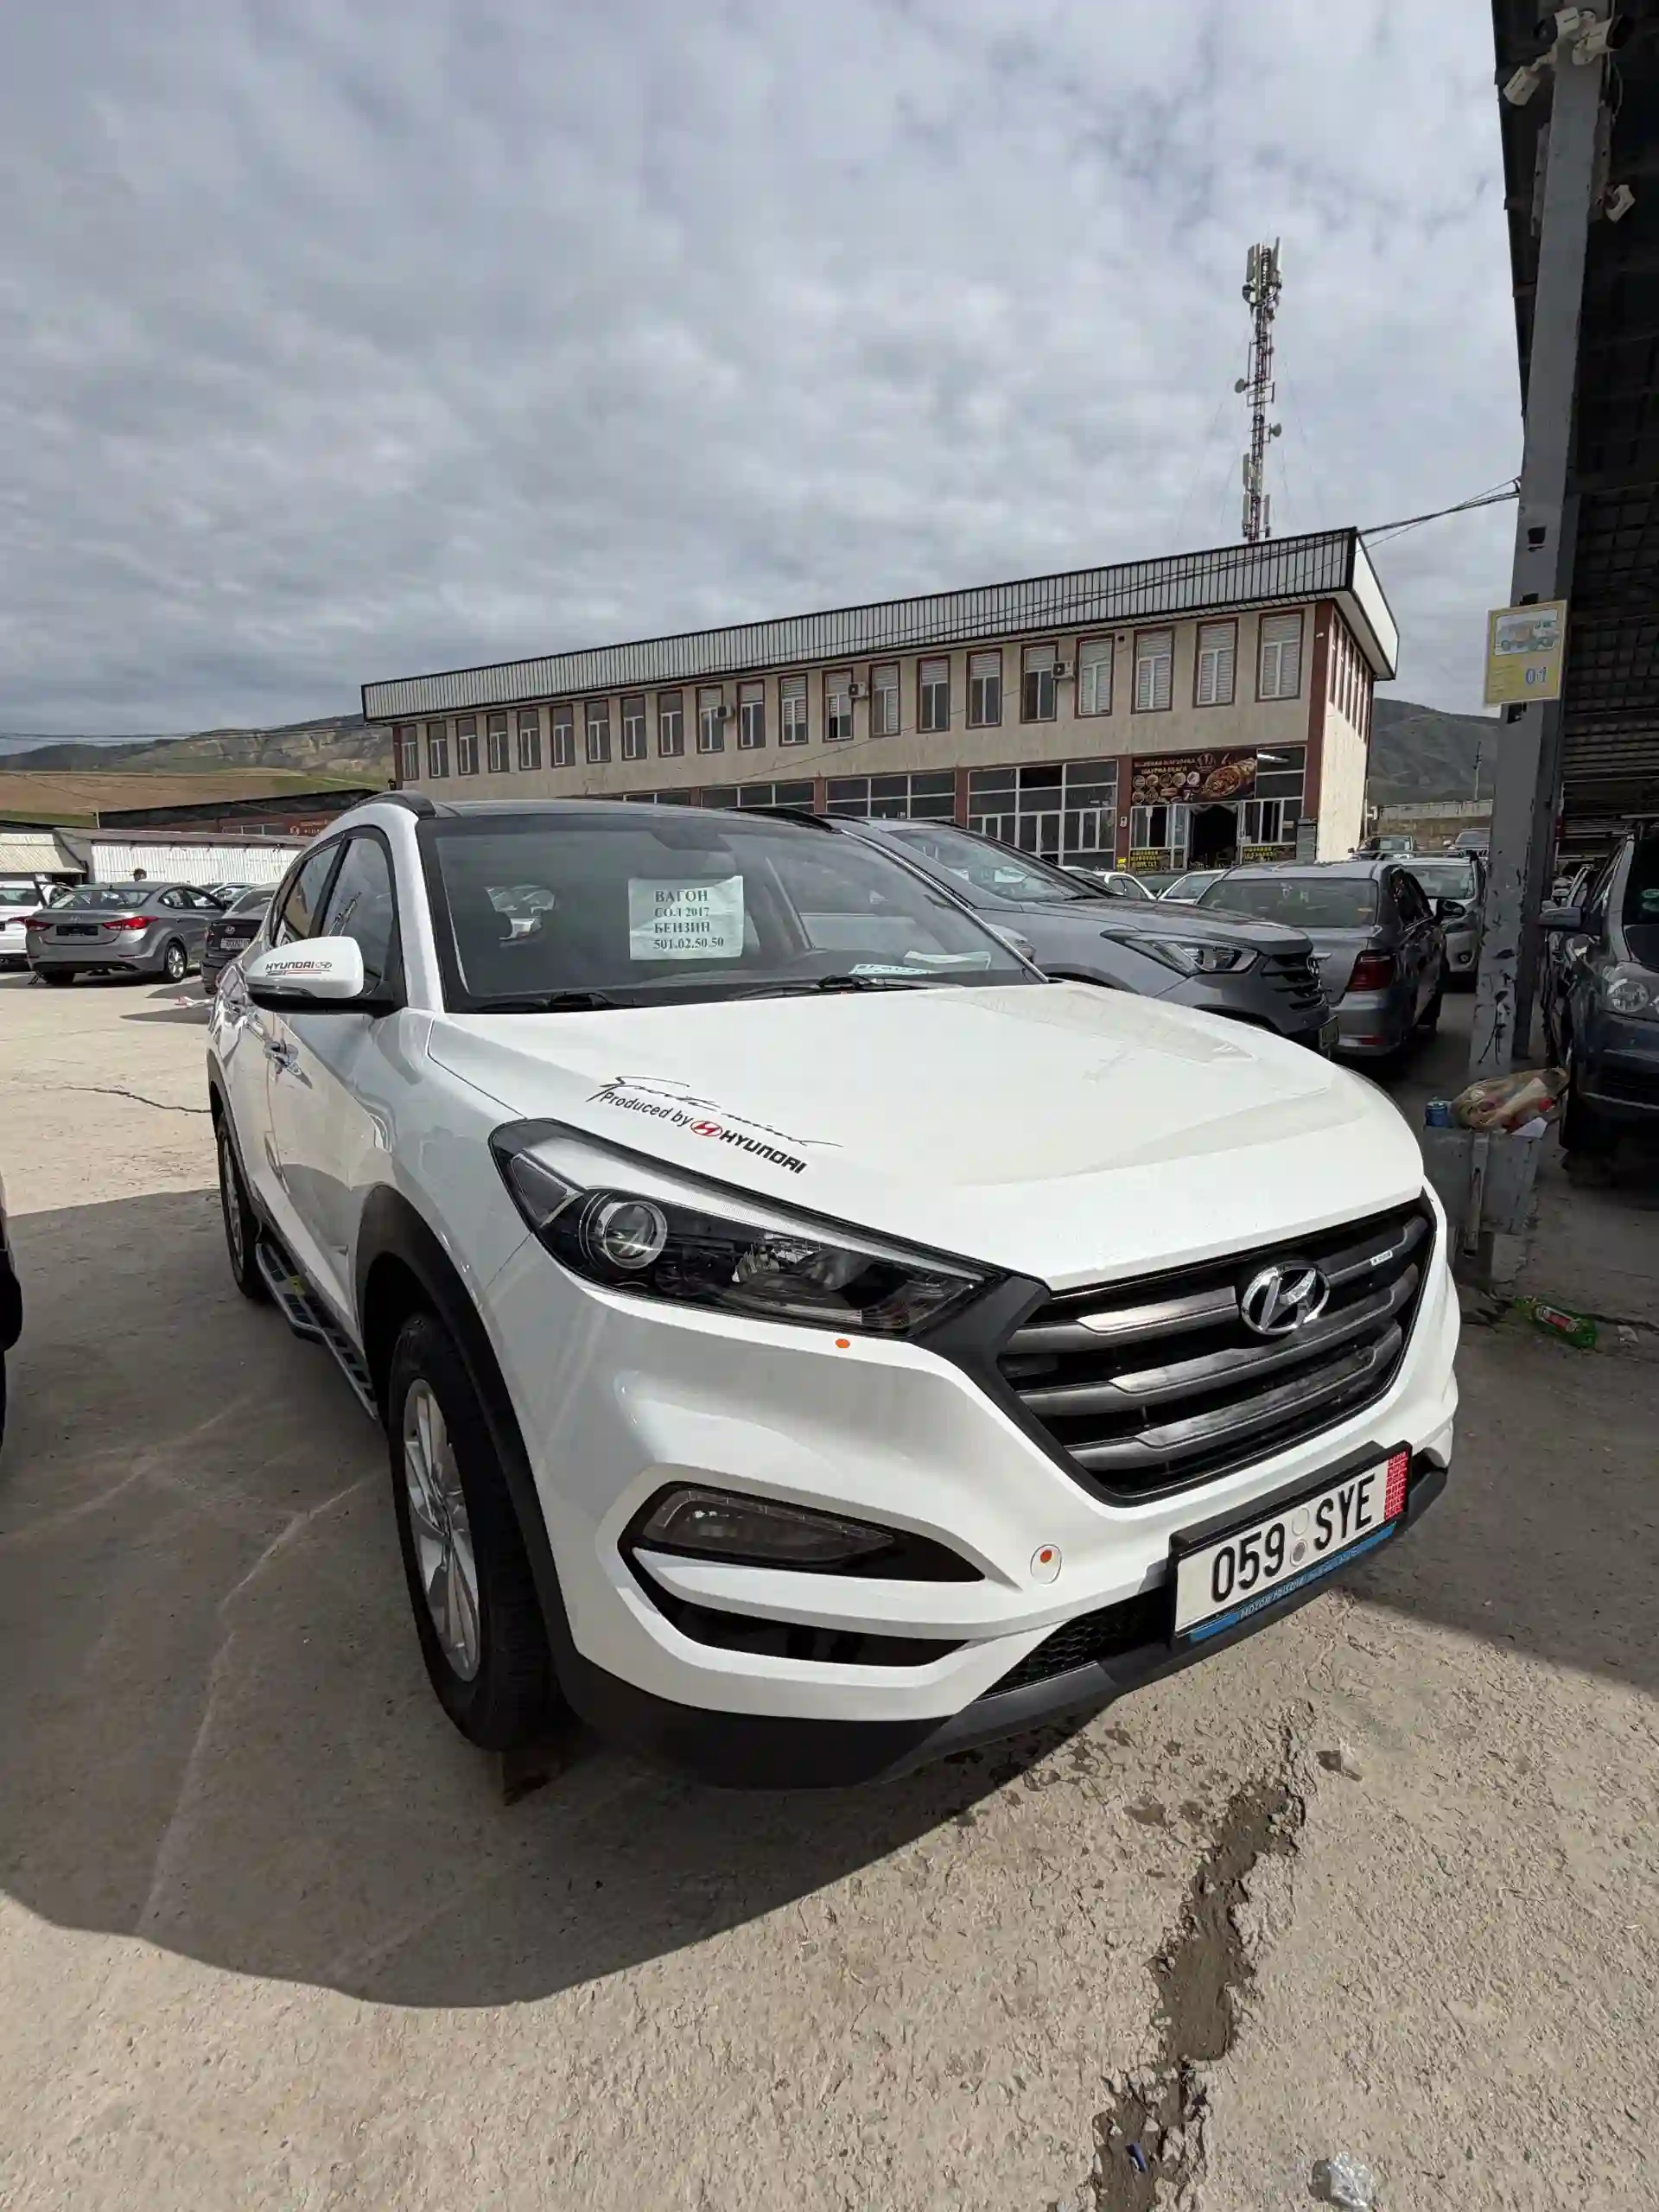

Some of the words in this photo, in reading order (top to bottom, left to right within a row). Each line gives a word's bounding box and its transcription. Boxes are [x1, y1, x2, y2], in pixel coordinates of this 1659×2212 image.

[1526, 667, 1546, 684] 01
[655, 890, 709, 903] ВАГОН
[685, 906, 710, 918] 2017
[653, 921, 710, 934] БЕНЗИН
[652, 937, 724, 950] 501.02.50.50
[265, 961, 315, 970] HYUNDAI
[600, 1091, 671, 1118] Produced
[671, 1110, 694, 1128] by
[720, 1130, 806, 1174] HYUNDAI
[1213, 1522, 1285, 1603] 059
[1313, 1472, 1376, 1550] SYE
